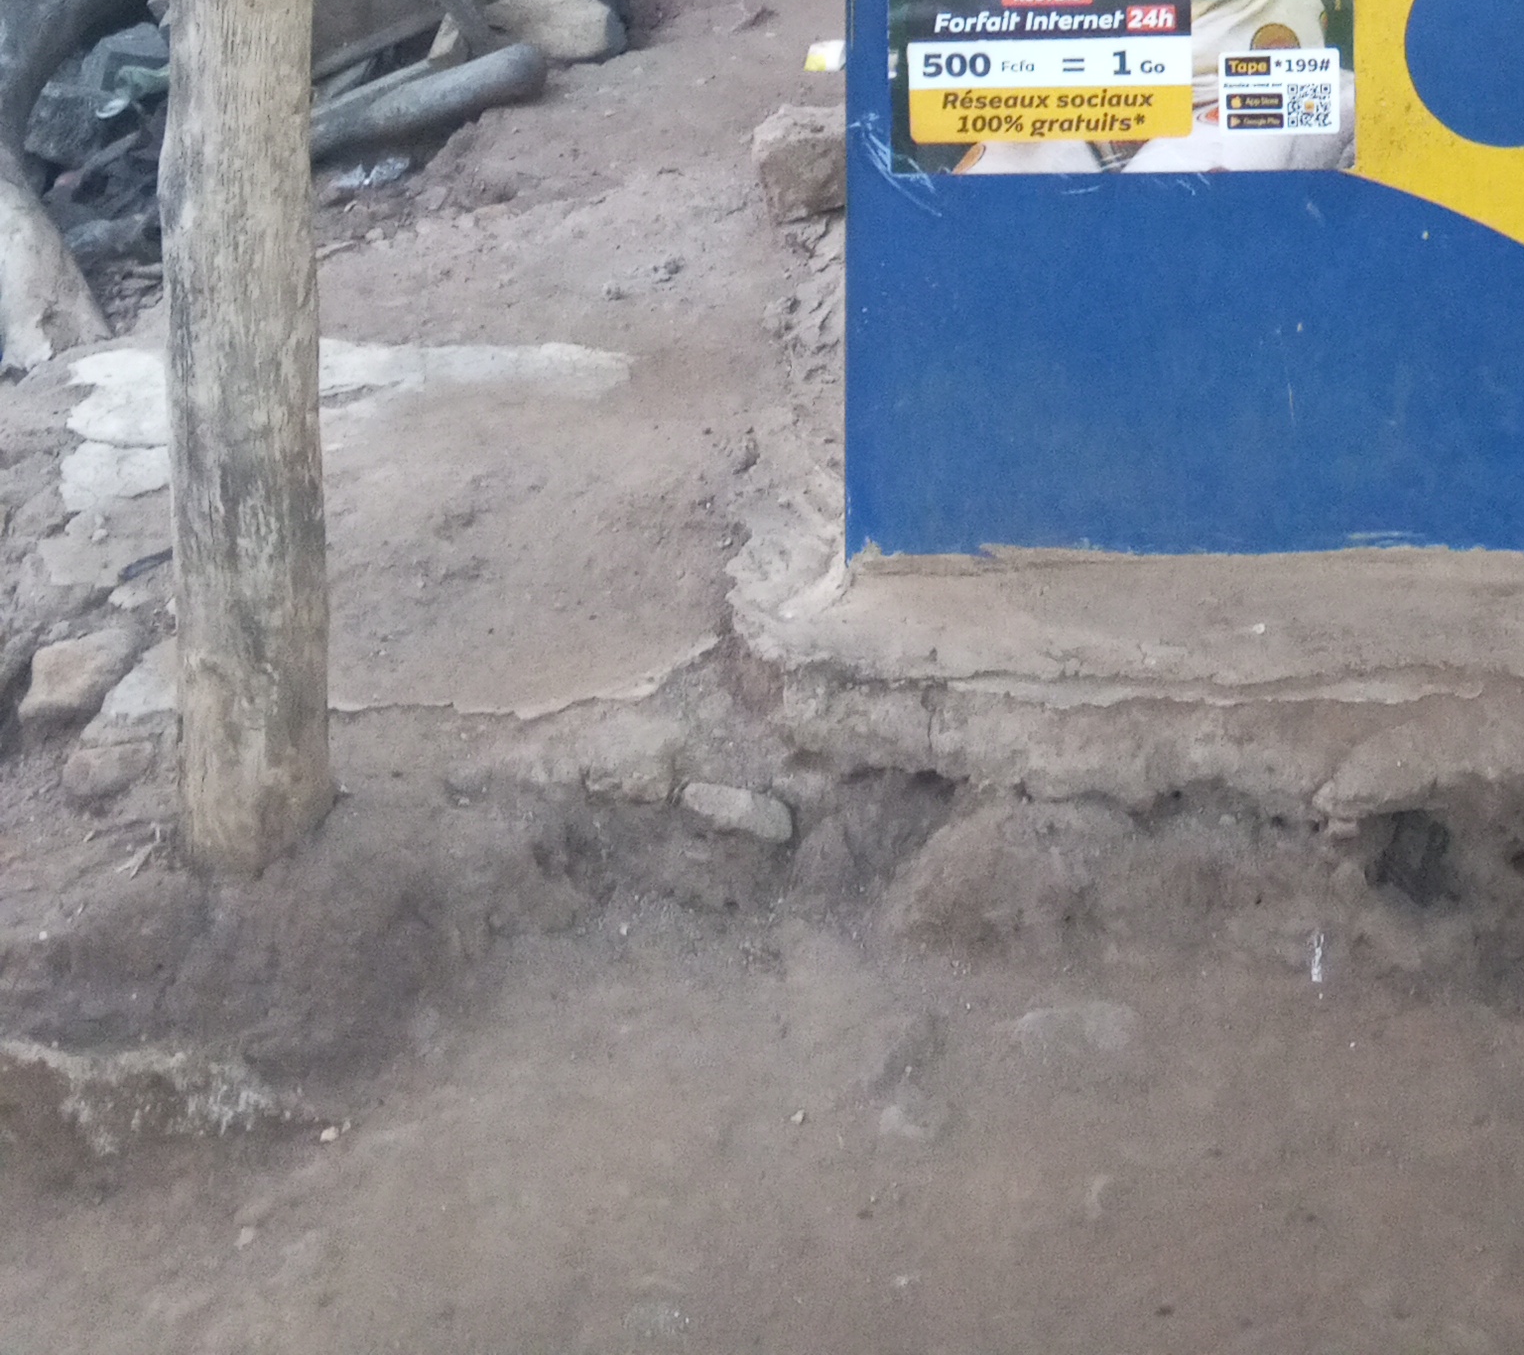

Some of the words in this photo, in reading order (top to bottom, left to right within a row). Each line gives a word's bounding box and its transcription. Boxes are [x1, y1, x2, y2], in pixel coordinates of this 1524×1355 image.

[934, 10, 1020, 33] Forfait
[1025, 10, 1124, 31] Internet
[1128, 8, 1175, 27] 24h
[922, 52, 991, 78] 500
[1001, 61, 1035, 73] Fcfa
[1113, 50, 1131, 75] 1
[1140, 60, 1165, 74] Go
[1228, 60, 1268, 75] Tape
[942, 90, 1050, 110] Réseaux
[1056, 89, 1154, 108] sociaux
[956, 115, 1024, 133] 100%
